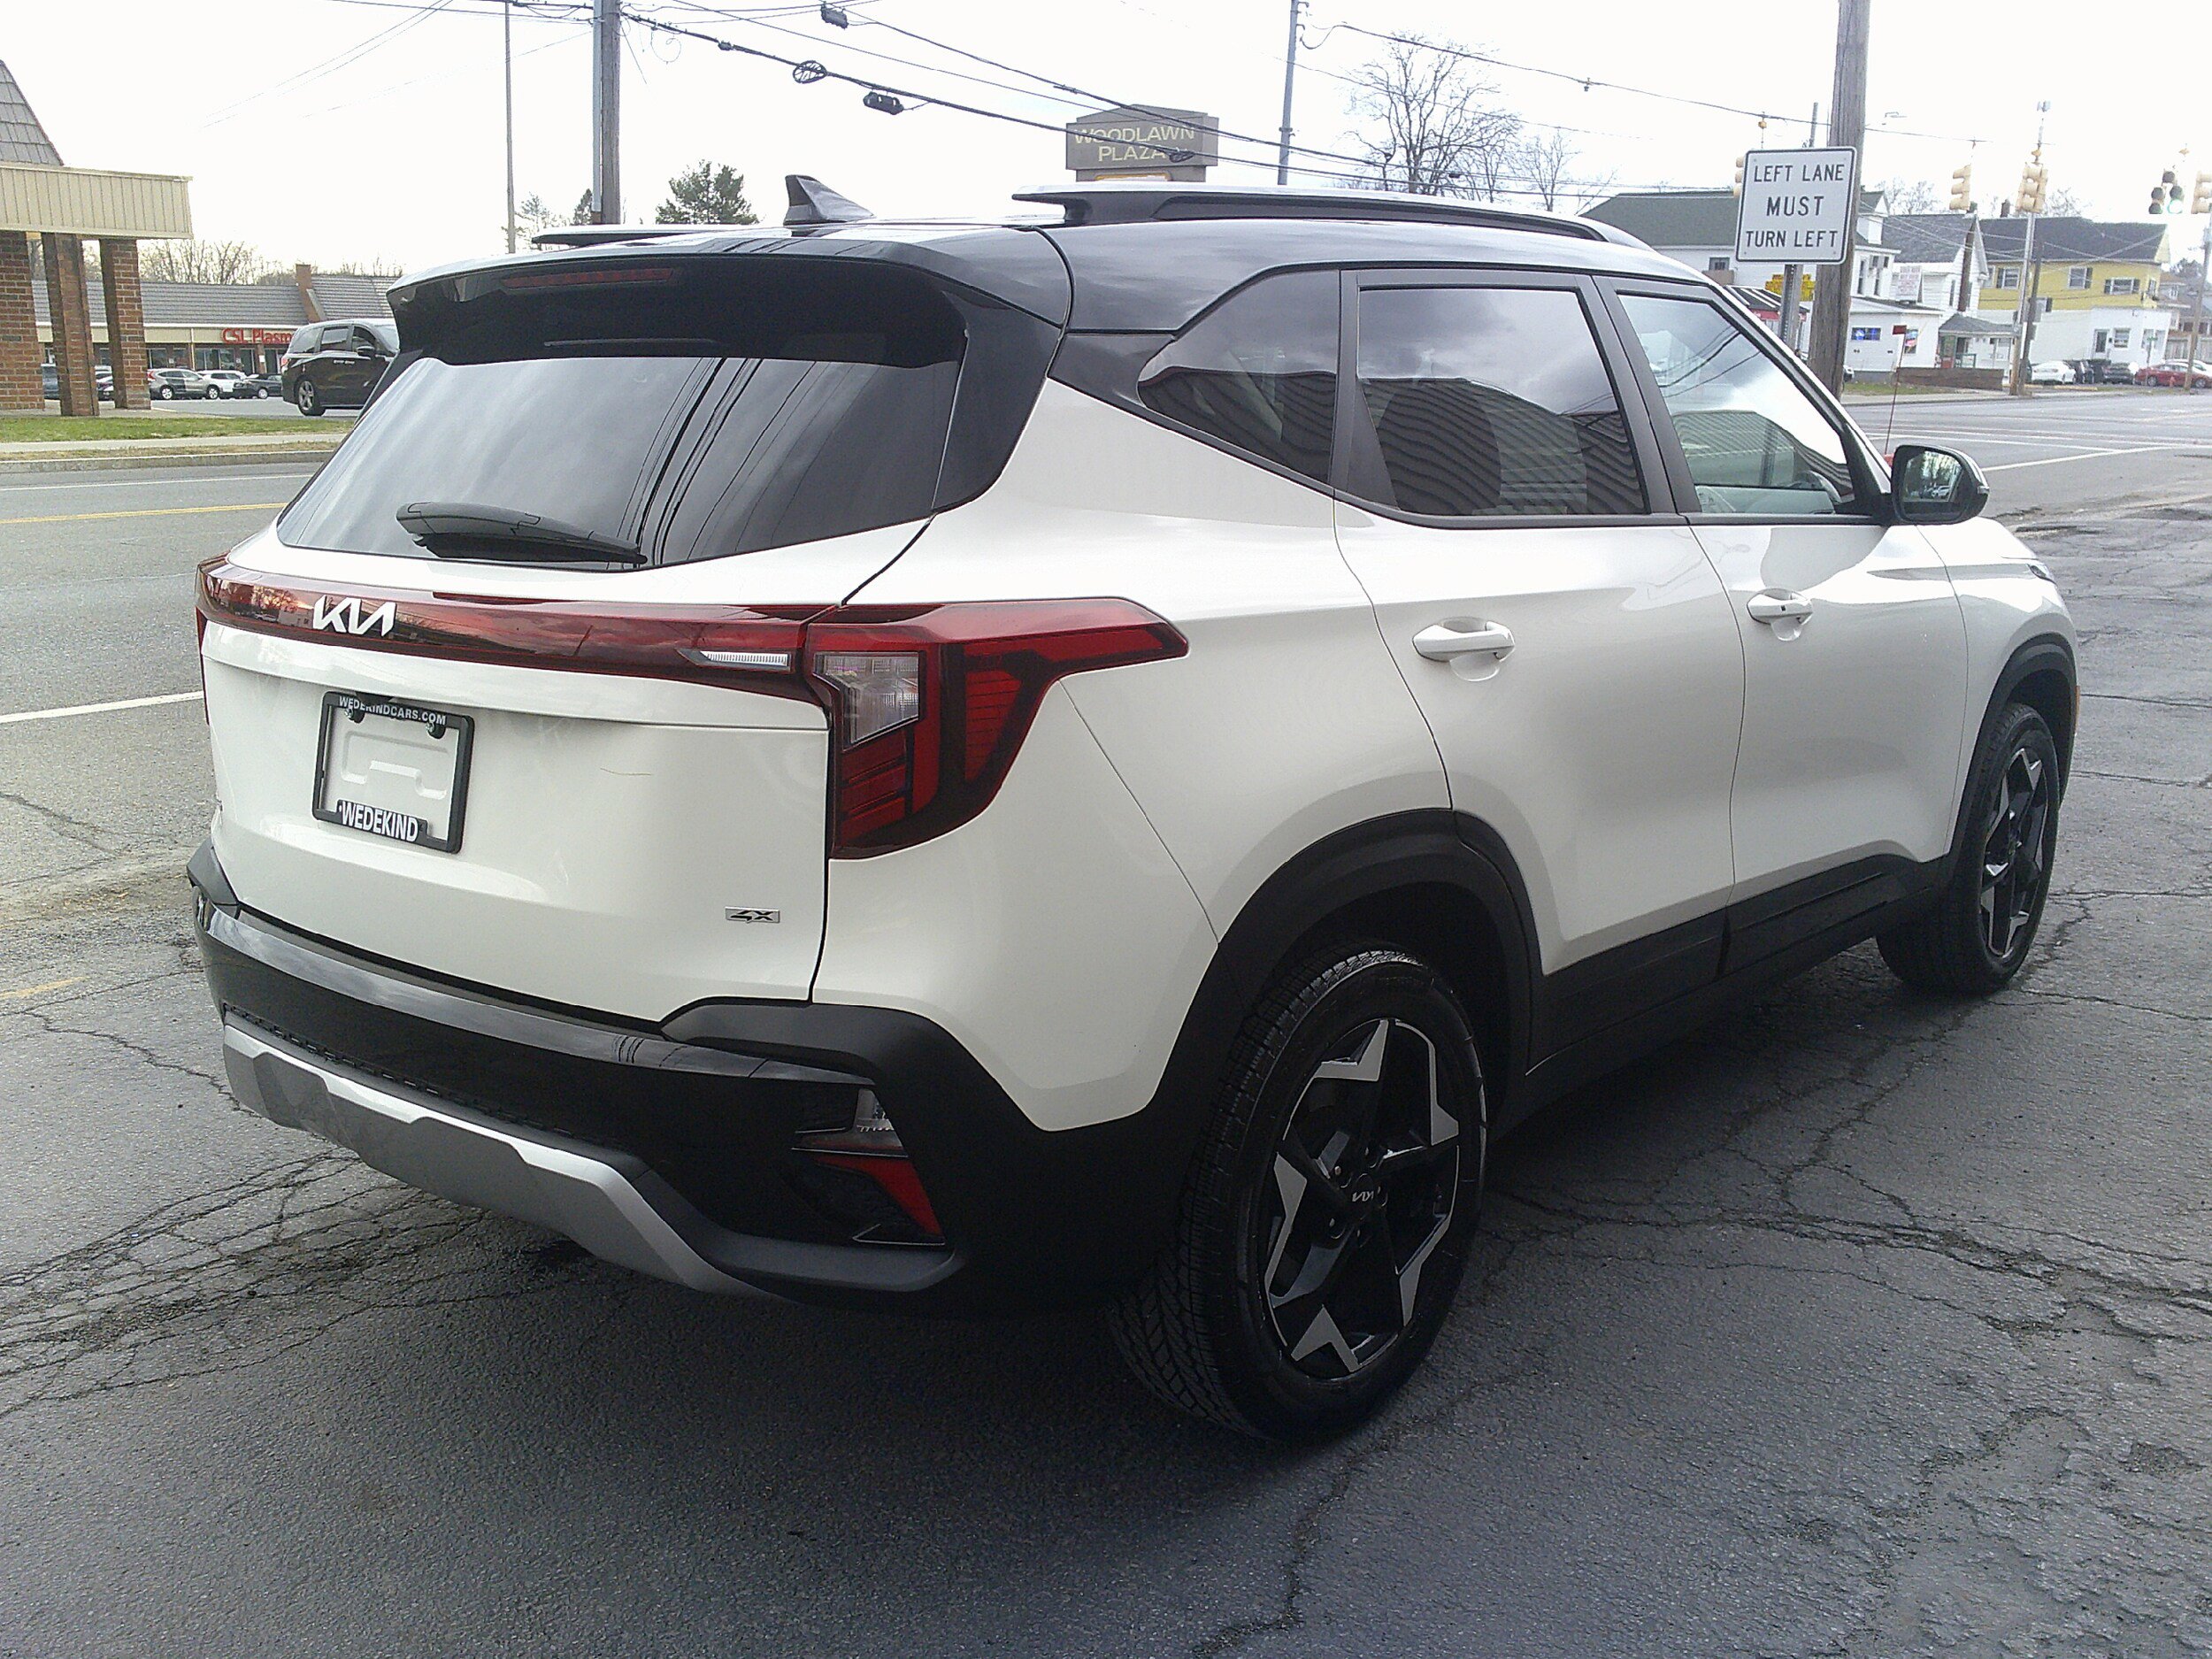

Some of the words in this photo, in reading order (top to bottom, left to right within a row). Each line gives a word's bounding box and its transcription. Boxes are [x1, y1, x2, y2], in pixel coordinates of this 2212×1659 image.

[1074, 127, 1194, 143] WOODLAWN
[1098, 146, 1166, 162] PLAZA
[1754, 165, 1793, 182] LEFT
[1801, 164, 1845, 181] LANE
[1766, 196, 1824, 216] MUST
[1746, 231, 1786, 248] TURN
[1793, 230, 1838, 248] LEFT
[222, 327, 248, 344] CSL
[252, 327, 293, 344] Plasm
[312, 594, 396, 637] KIA
[342, 801, 419, 842] WEDEKIND
